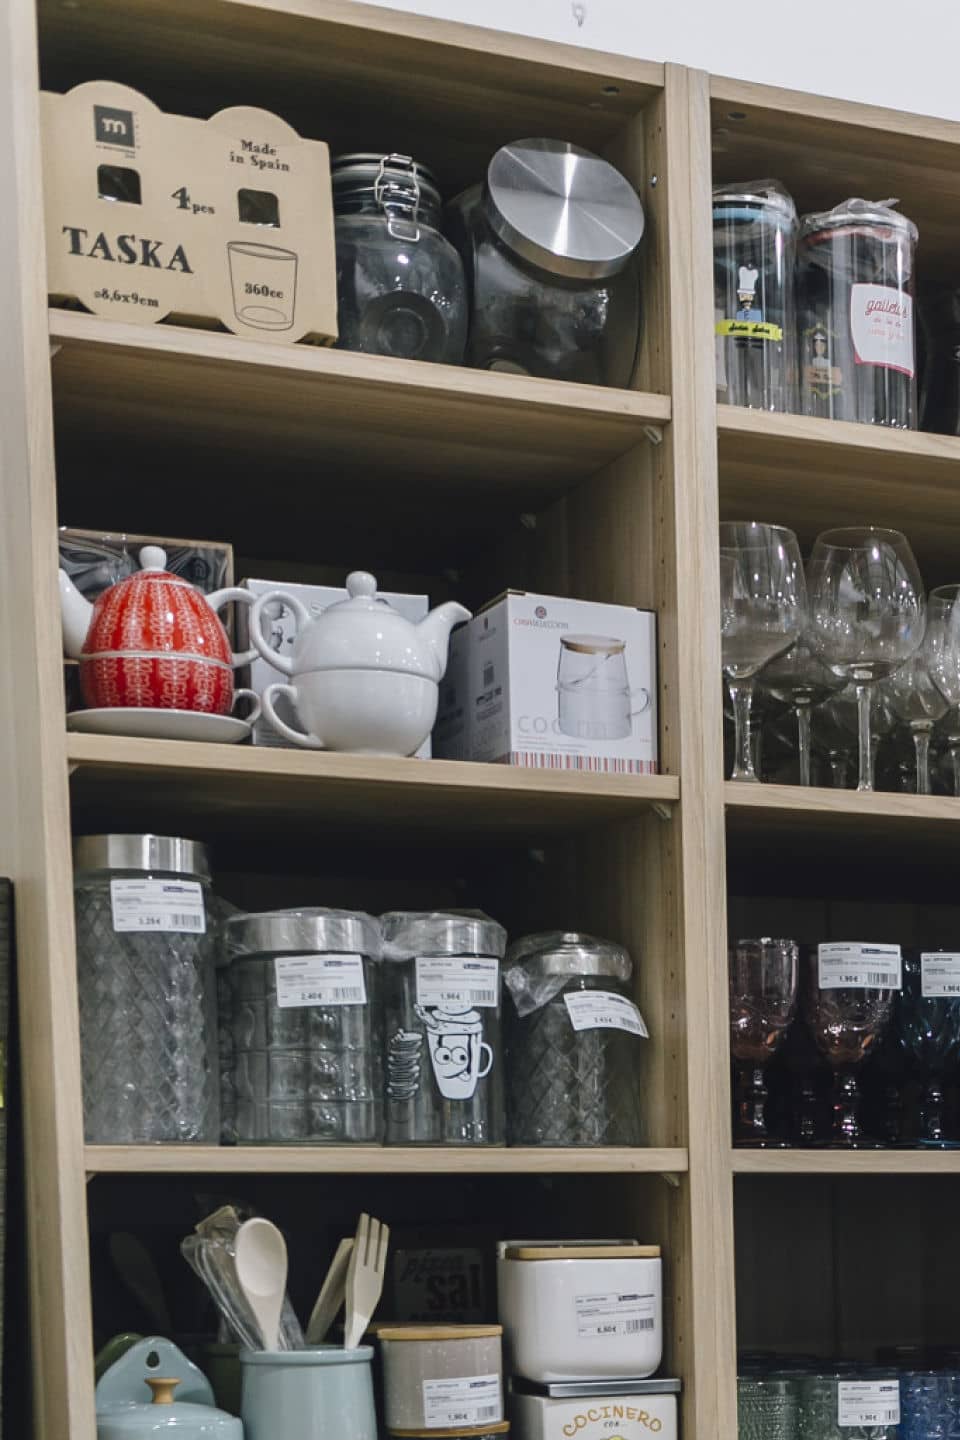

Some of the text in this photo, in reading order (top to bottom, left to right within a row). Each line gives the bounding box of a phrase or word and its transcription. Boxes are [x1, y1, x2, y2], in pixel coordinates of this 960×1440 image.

[240, 139, 277, 156] Made
[230, 151, 290, 172] in Spain
[171, 186, 215, 214] 4 pcs
[62, 226, 194, 274] TASKA
[244, 282, 284, 299] 360cc
[563, 1406, 662, 1437] COCINERO
